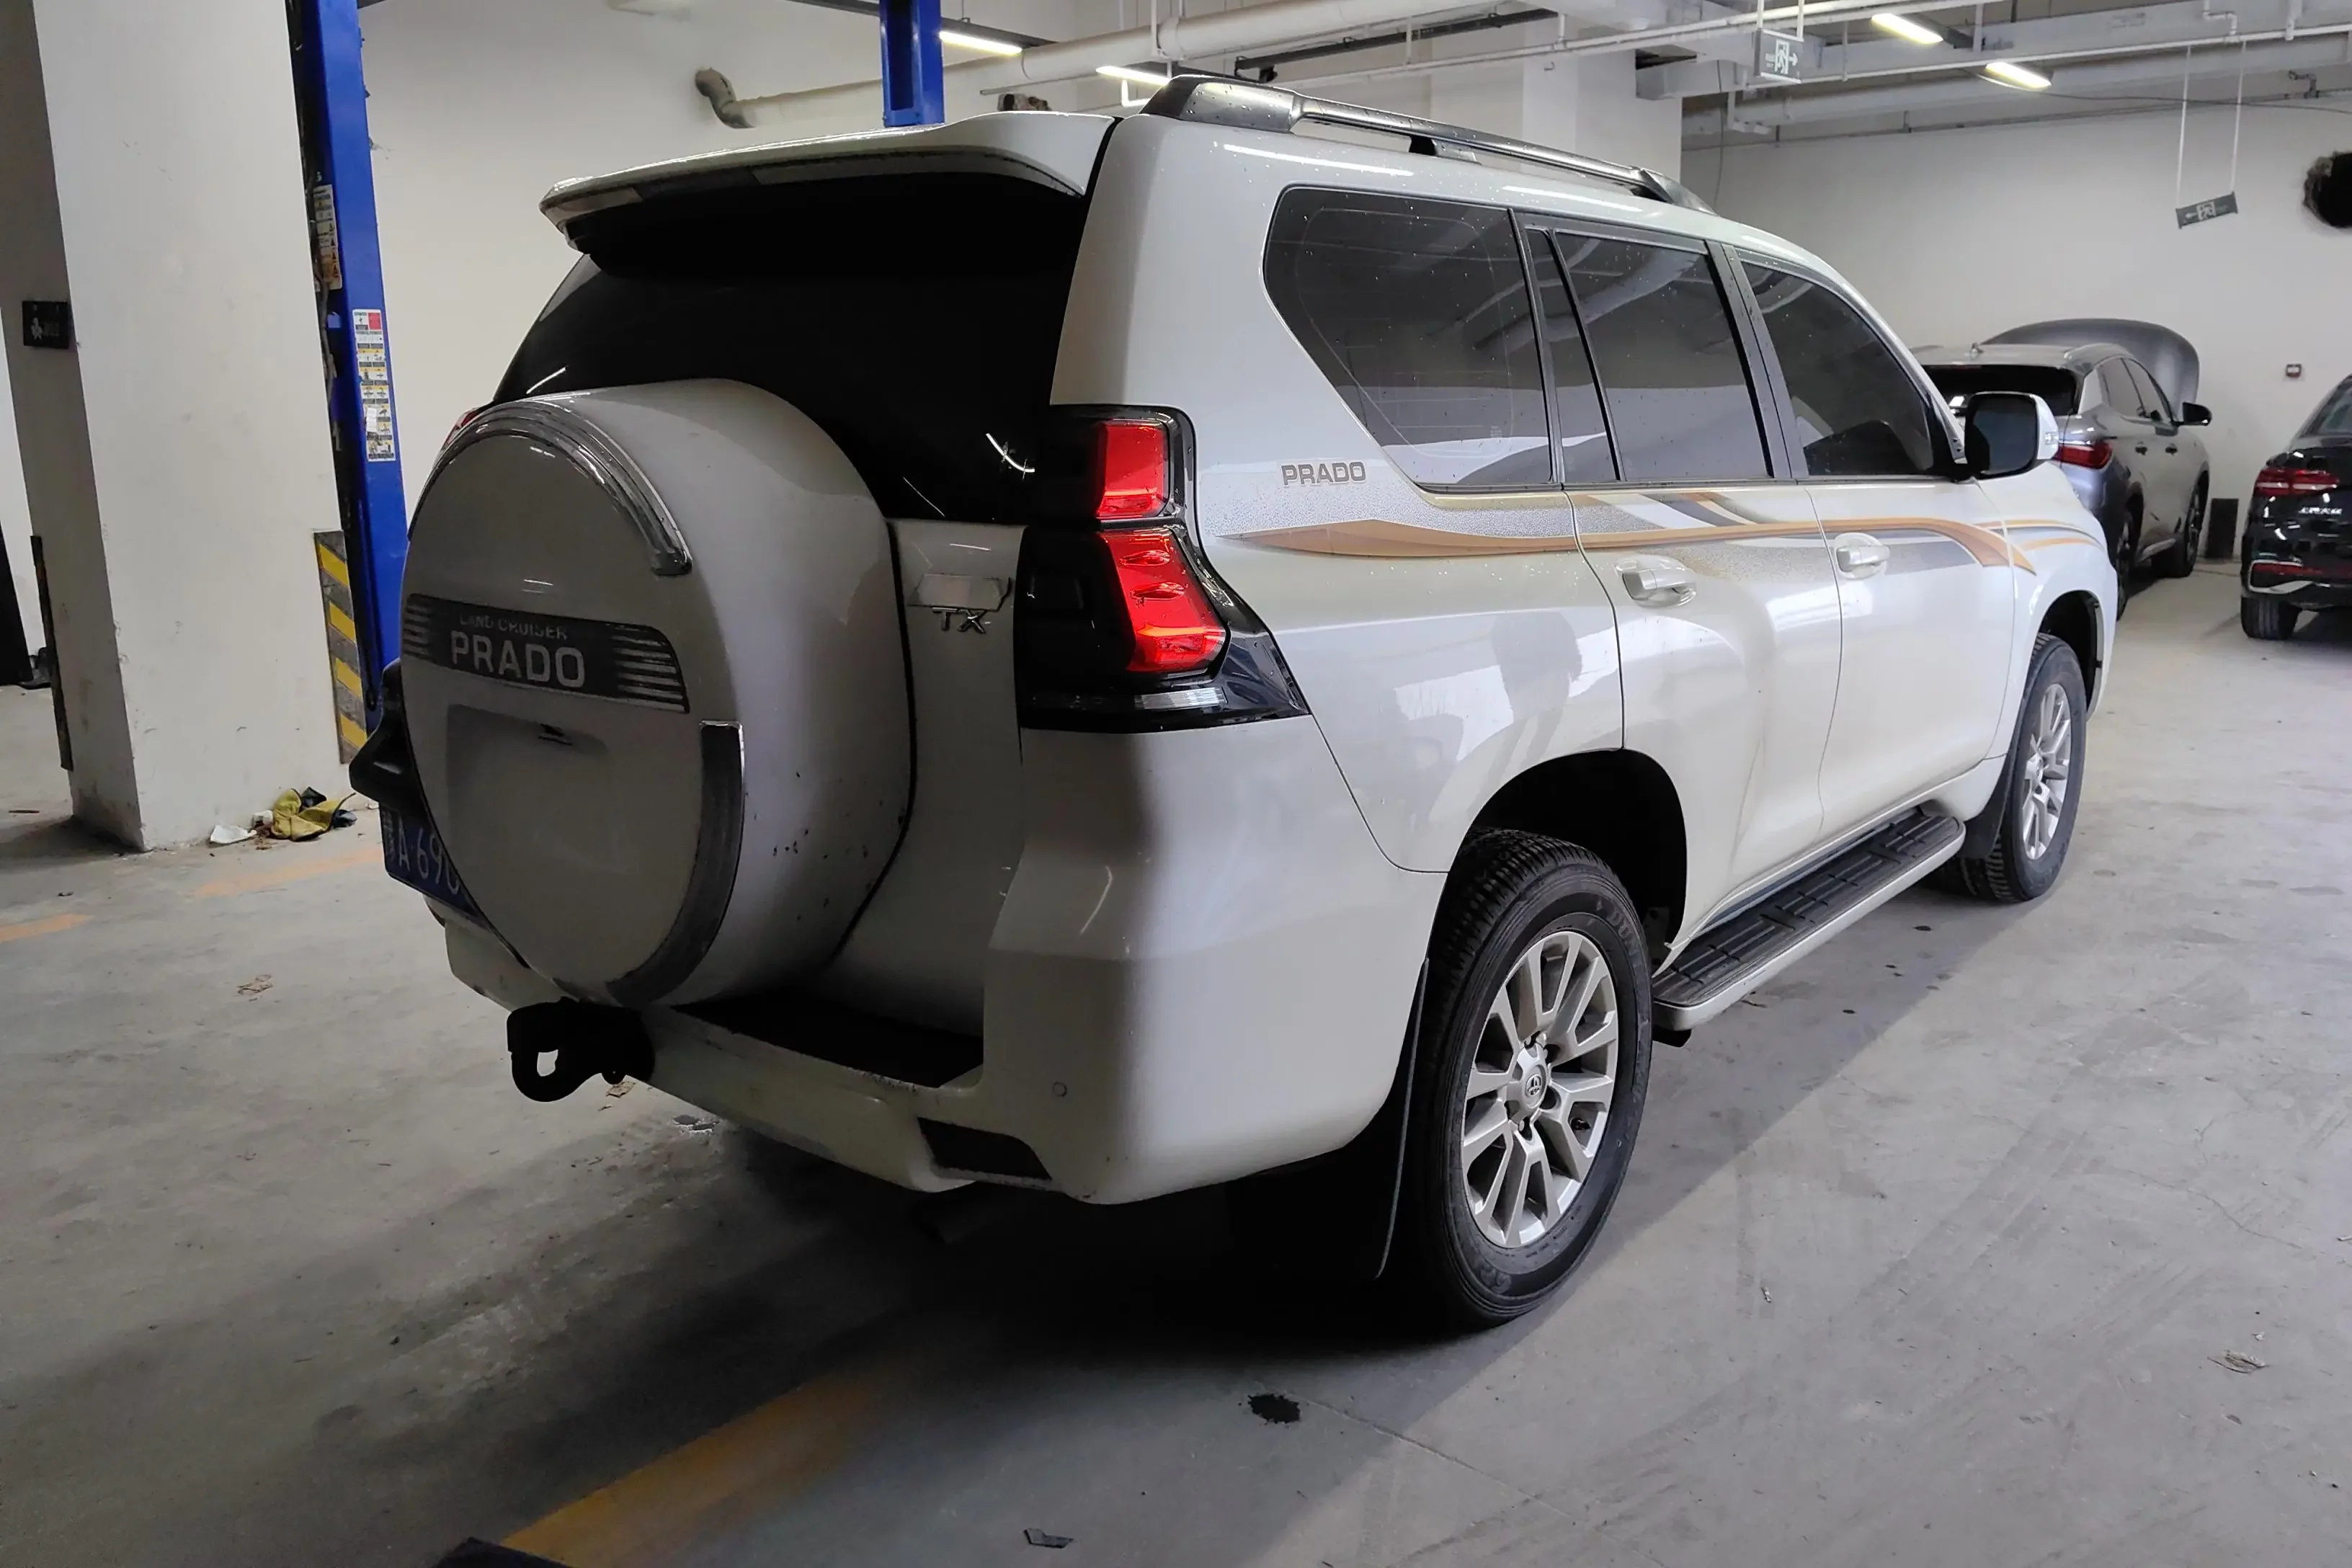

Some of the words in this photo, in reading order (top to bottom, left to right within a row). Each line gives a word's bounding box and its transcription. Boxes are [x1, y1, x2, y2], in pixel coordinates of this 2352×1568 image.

[1281, 462, 1366, 486] PRADO
[498, 618, 569, 641] CRUISER
[450, 630, 585, 688] PRADO
